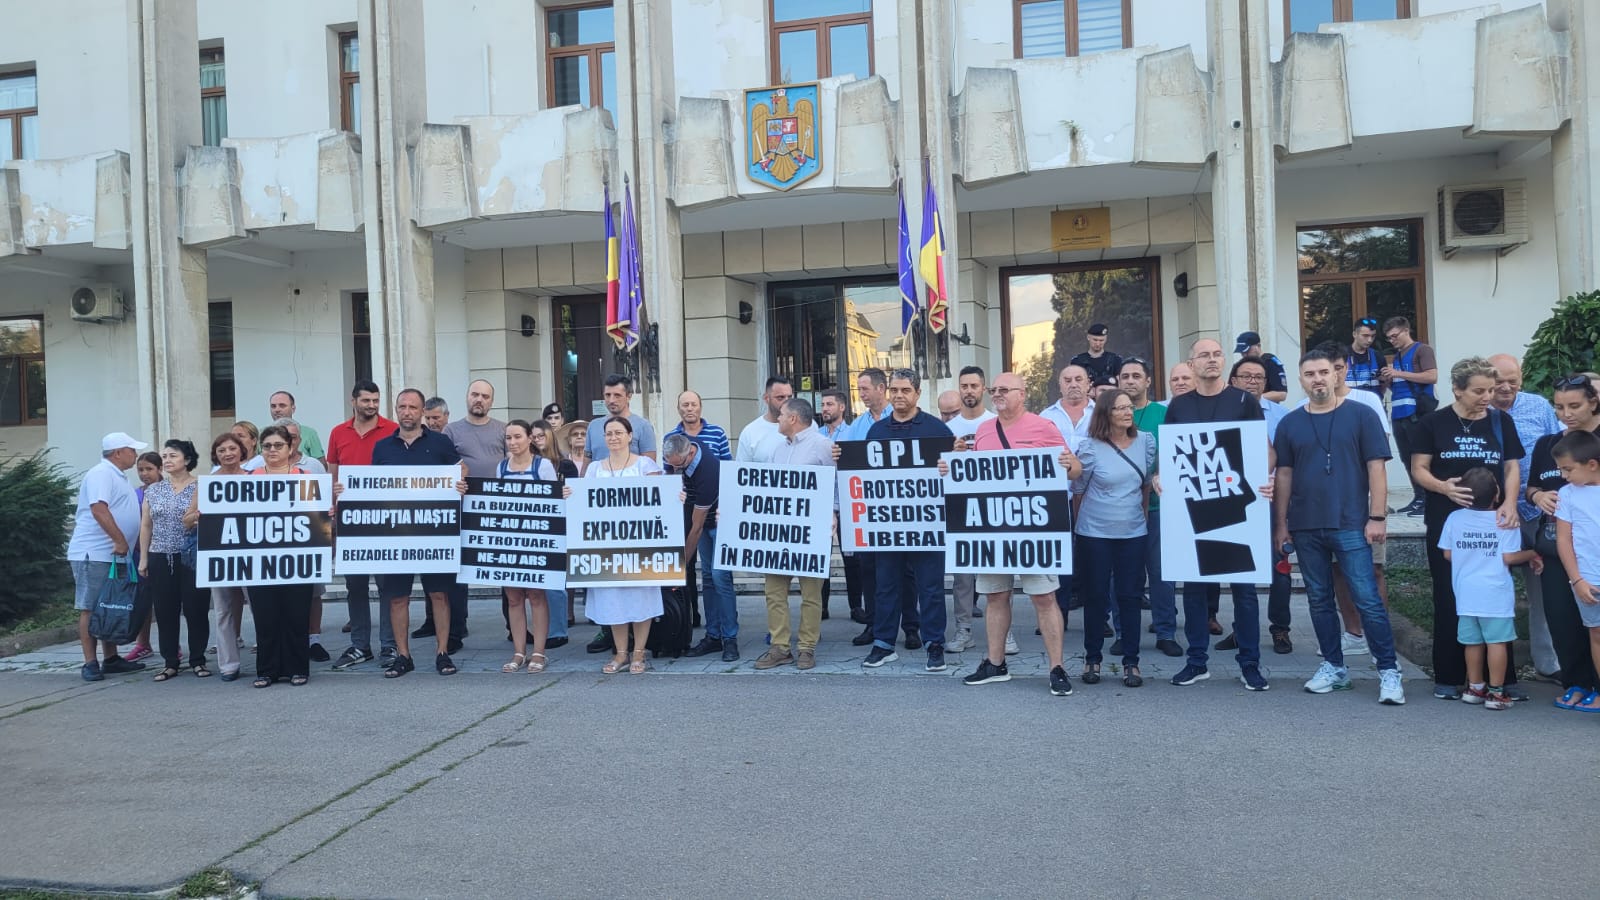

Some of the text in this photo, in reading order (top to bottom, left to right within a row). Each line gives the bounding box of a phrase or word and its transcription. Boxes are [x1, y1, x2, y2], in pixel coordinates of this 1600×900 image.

[1172, 430, 1216, 454] NU
[951, 454, 1056, 486] CORUPȚIA
[1173, 444, 1231, 477] AM
[348, 474, 453, 489] ÎN FIECARE NOAPTE
[482, 482, 552, 494] NE-AU ARS
[738, 468, 818, 490] CREVEDIA
[1178, 462, 1244, 501] AER
[208, 480, 322, 507] CORUPȚIA
[588, 486, 661, 508] FORMULA
[471, 500, 562, 514] LA BUZUNARE.
[742, 495, 810, 517] POATE FI
[966, 496, 1048, 527] A UCIS
[220, 516, 310, 544] A UCIS
[342, 509, 456, 528] CORUPȚIA NAȘTE
[480, 517, 550, 530] NE-AU ARS
[582, 516, 668, 540] EXPLOZIVĂ:
[468, 535, 559, 549] PE TROTUARE.
[738, 521, 811, 544] ORIUNDE
[342, 548, 454, 561] BEIZADELE DROGATE!
[477, 552, 547, 566] NE-AU ARS
[570, 551, 682, 575] PSD+PNL+GPL
[721, 544, 825, 574] ÎN ROMÂNIA!
[956, 539, 1062, 568] DIN NOU!
[208, 554, 322, 582] DIN NOU!
[476, 569, 545, 583] ÎN SPITALE
